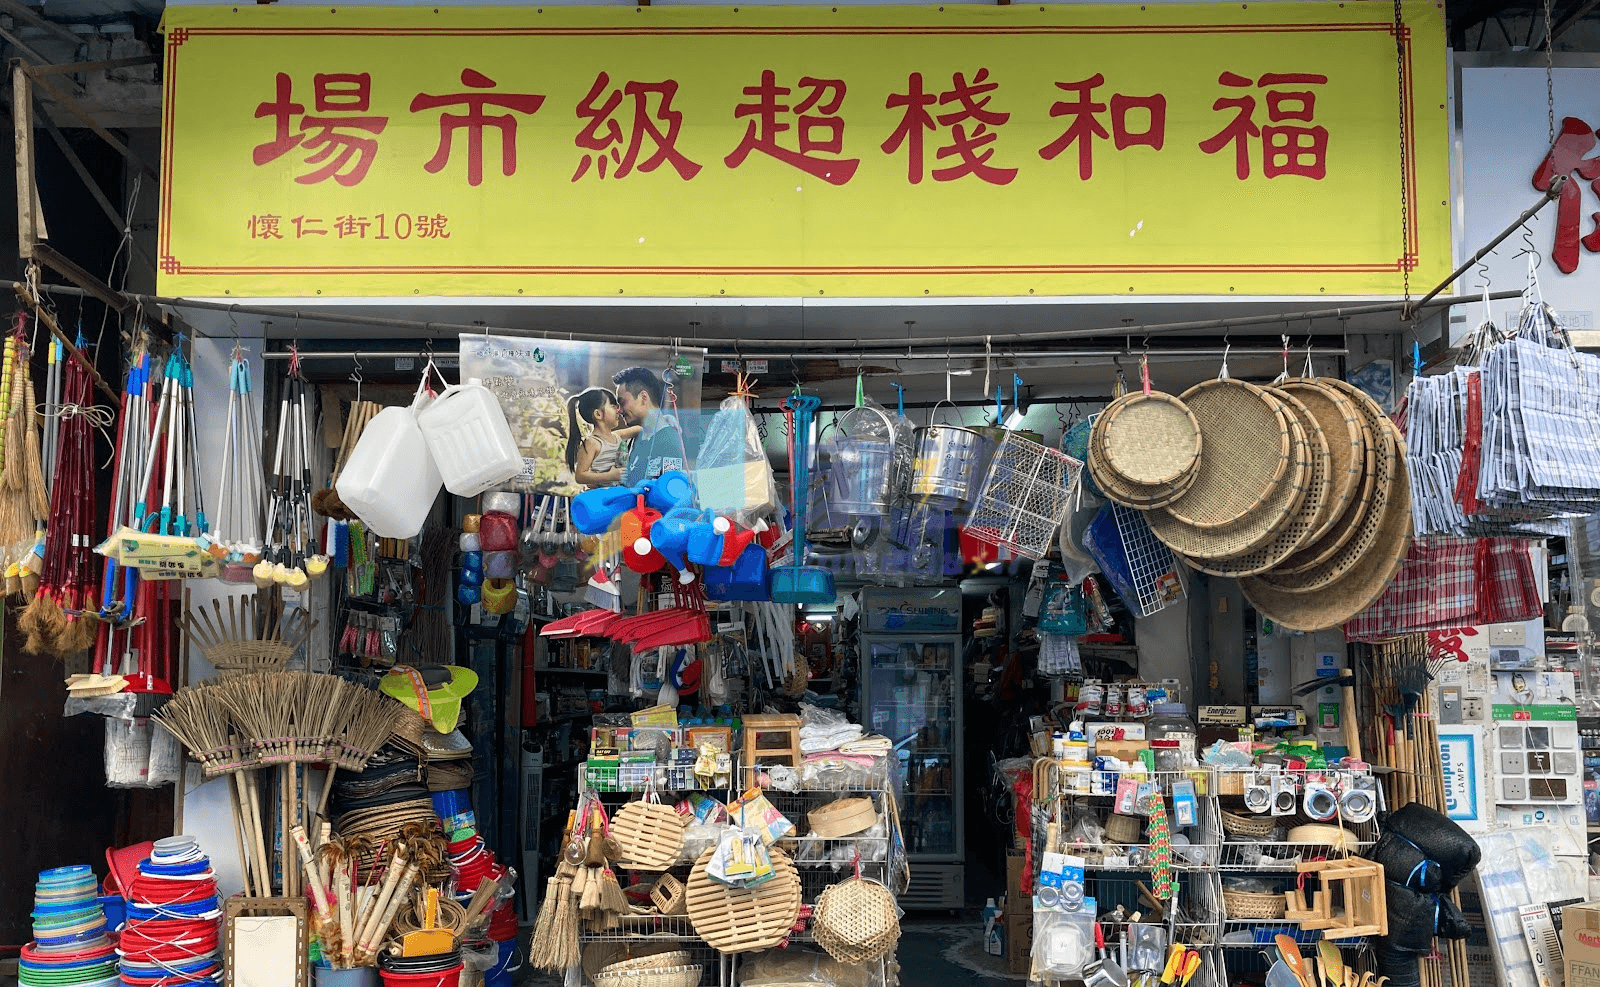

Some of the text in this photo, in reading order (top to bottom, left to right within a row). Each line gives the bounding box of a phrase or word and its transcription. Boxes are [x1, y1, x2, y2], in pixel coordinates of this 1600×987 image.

[247, 213, 451, 241] 懷仁街10號
[1206, 706, 1238, 716] Energizer
[1457, 761, 1466, 795] LAMPS
